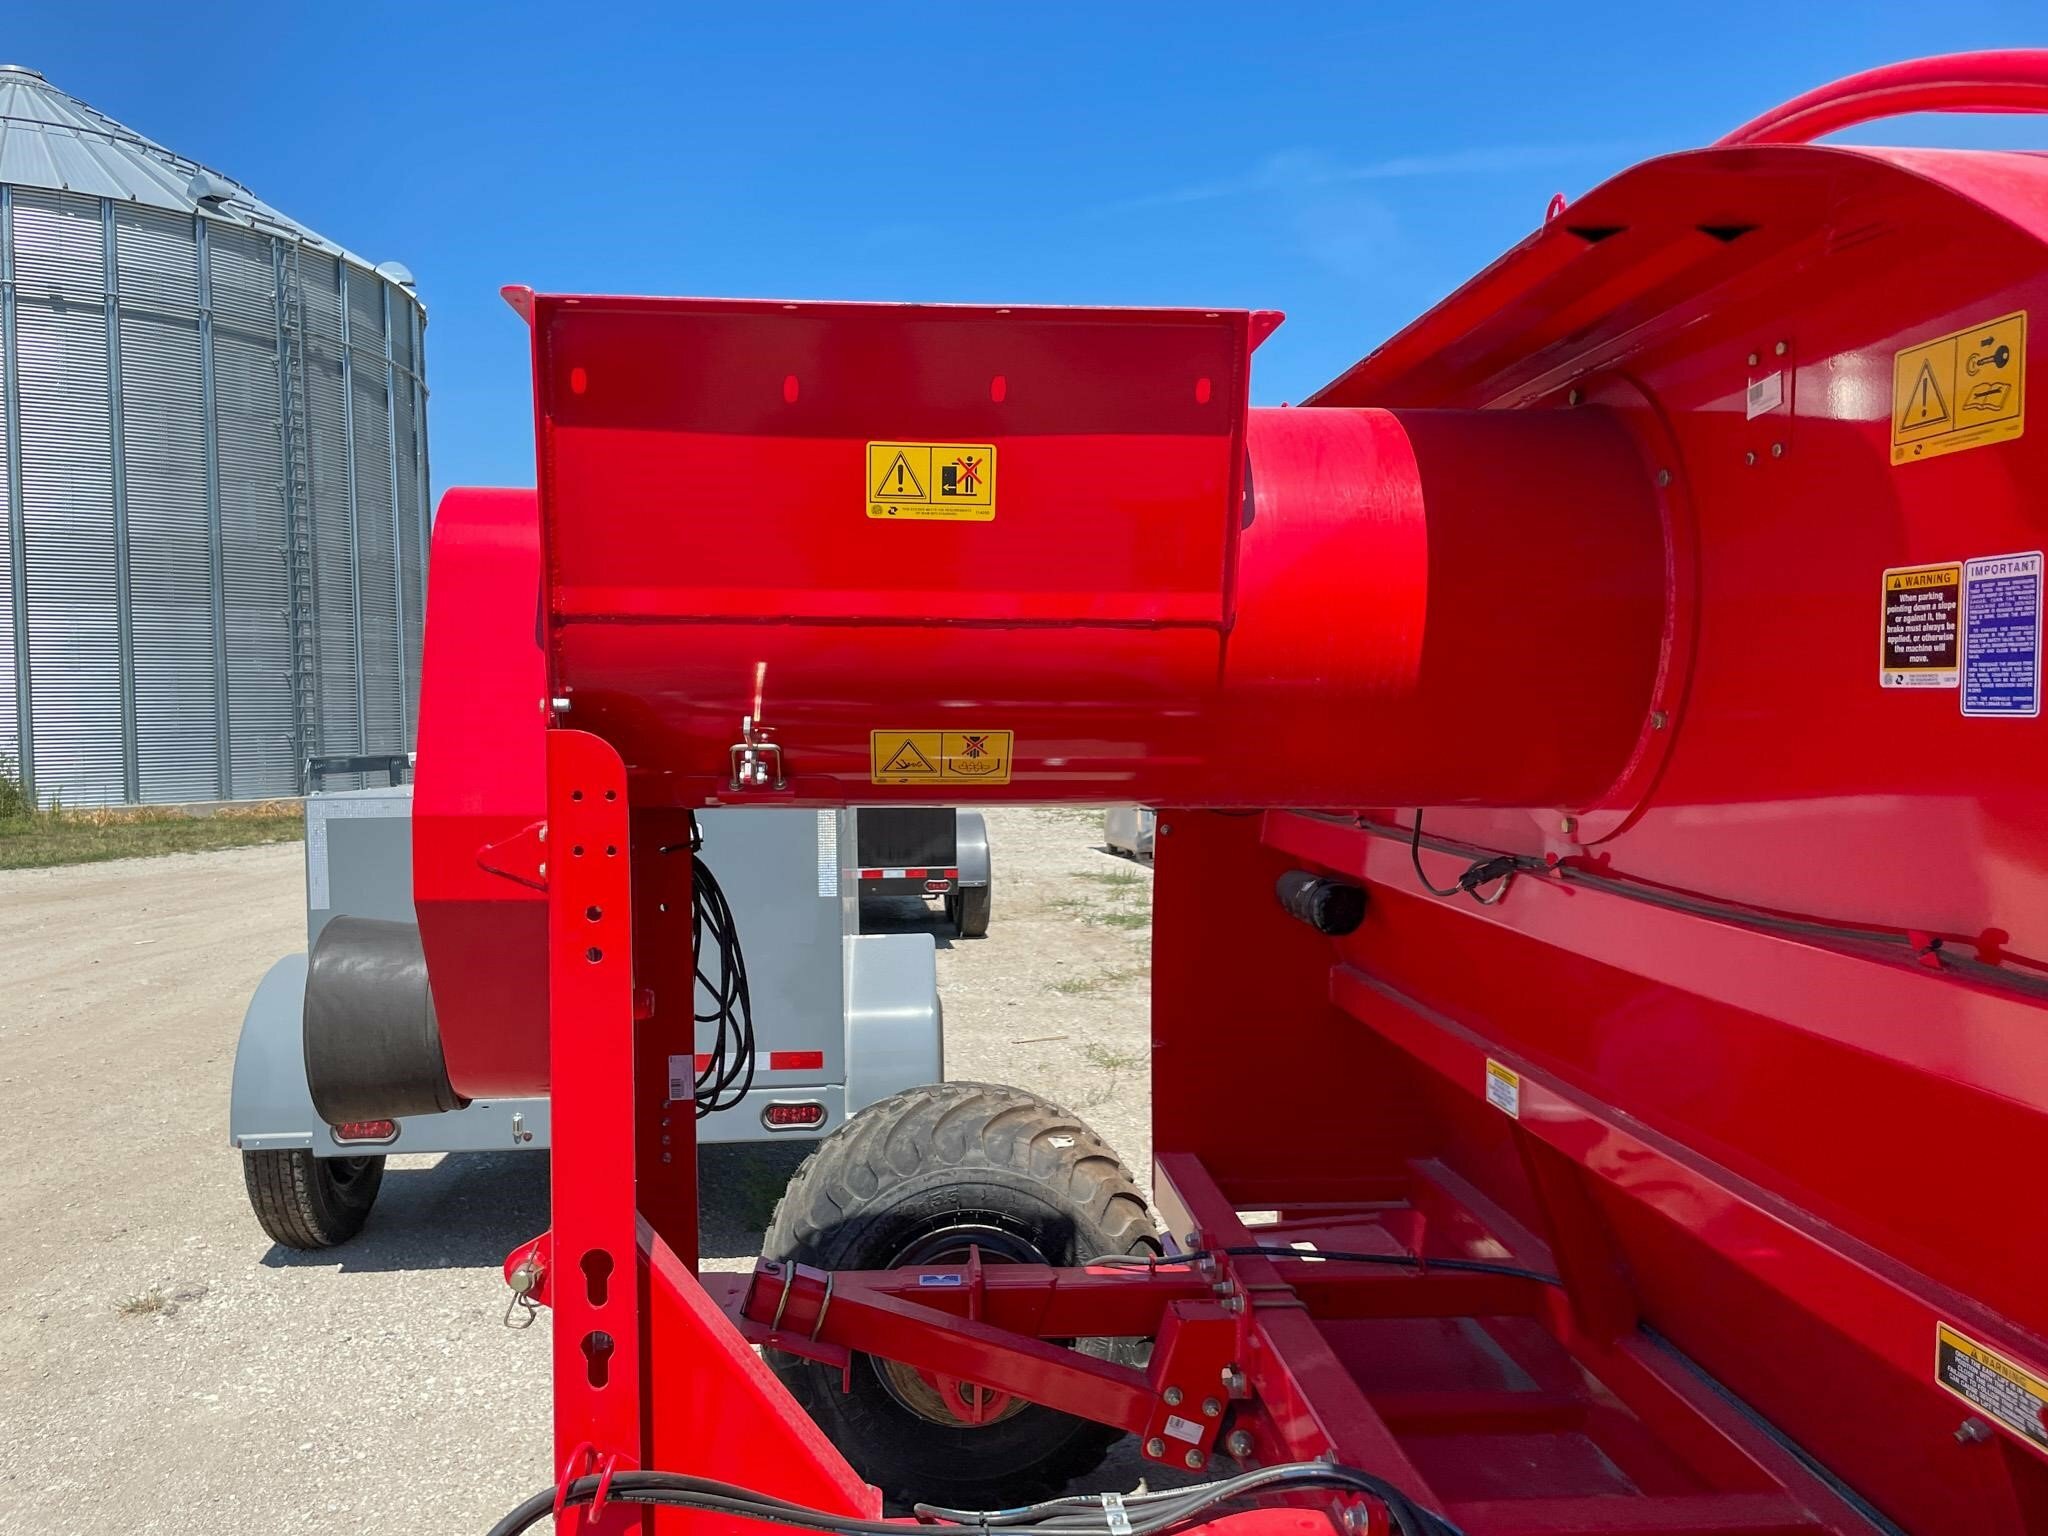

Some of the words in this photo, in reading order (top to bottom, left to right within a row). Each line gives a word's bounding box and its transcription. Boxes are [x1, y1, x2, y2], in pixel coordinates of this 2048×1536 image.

[1971, 560, 2035, 577] IMPORTANT
[1905, 573, 1951, 587] WARNING
[1899, 594, 1917, 603] When
[1918, 592, 1943, 602] parking
[1886, 604, 1912, 615] pointing
[1913, 603, 1931, 611] down
[1937, 601, 1956, 612] slope
[1903, 613, 1926, 624] against
[1935, 612, 1946, 620] the
[1886, 625, 1904, 633] brake
[1905, 624, 1922, 632] must
[1922, 623, 1945, 633] always
[1946, 622, 1955, 630] be
[1921, 633, 1954, 641] otherwise
[1894, 645, 1905, 653] the
[1905, 644, 1933, 653] machine
[1933, 643, 1946, 652] will
[1909, 655, 1929, 663] move.
[1982, 1354, 2026, 1387] WARNING
